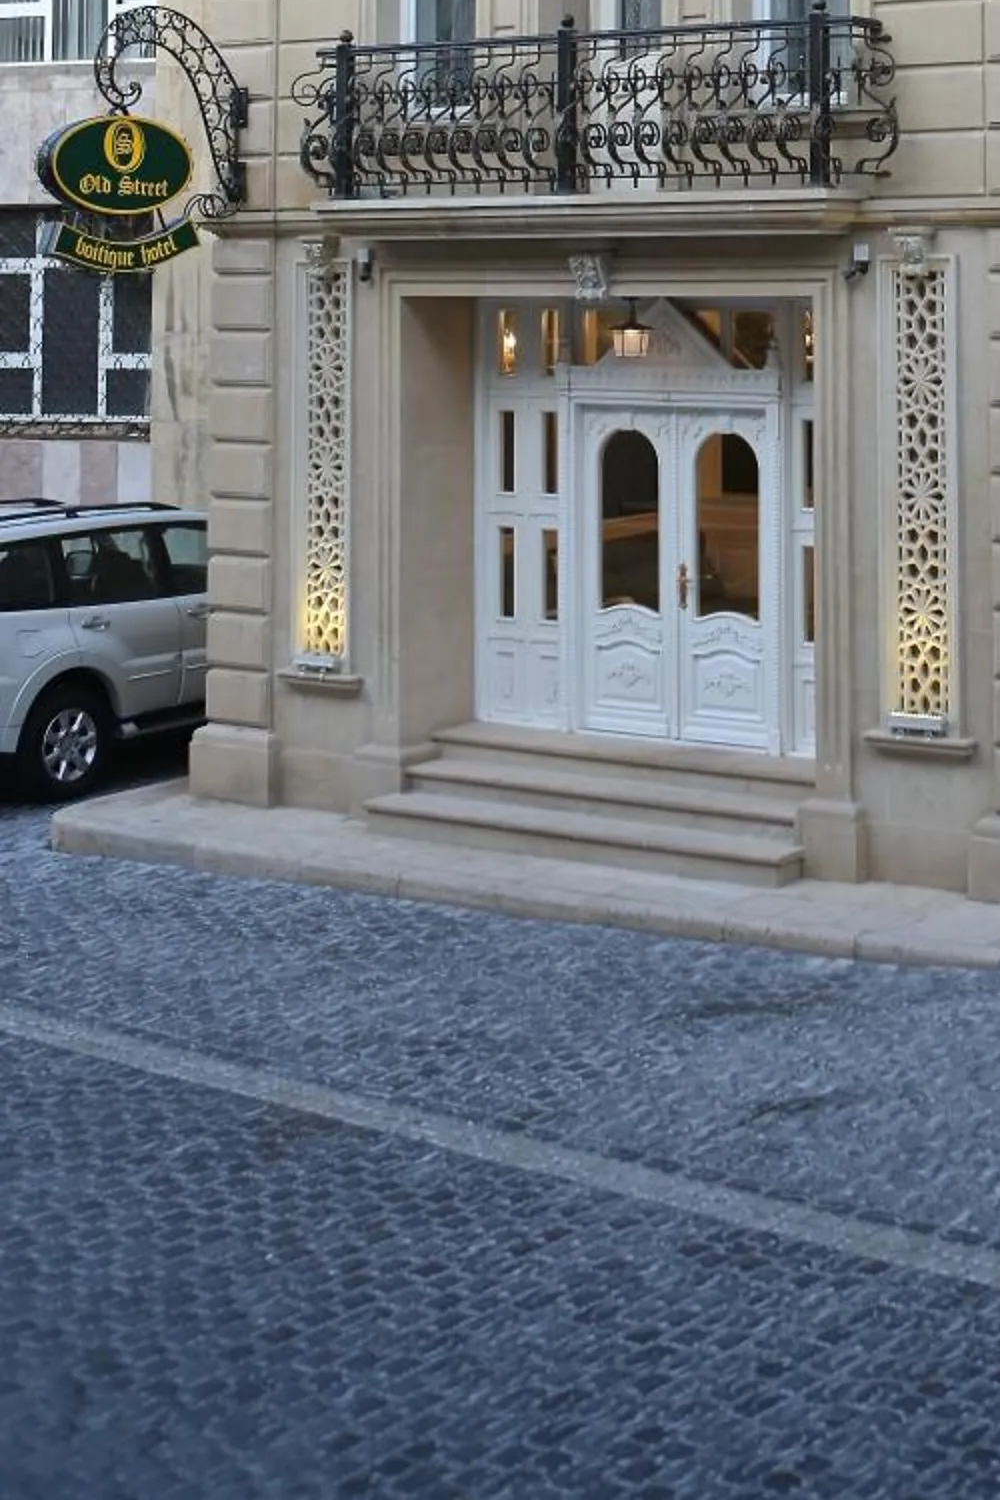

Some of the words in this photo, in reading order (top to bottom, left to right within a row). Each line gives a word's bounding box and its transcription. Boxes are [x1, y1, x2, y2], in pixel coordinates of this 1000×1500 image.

[79, 174, 111, 194] Old
[117, 175, 168, 196] Street
[141, 234, 177, 265] hotel
